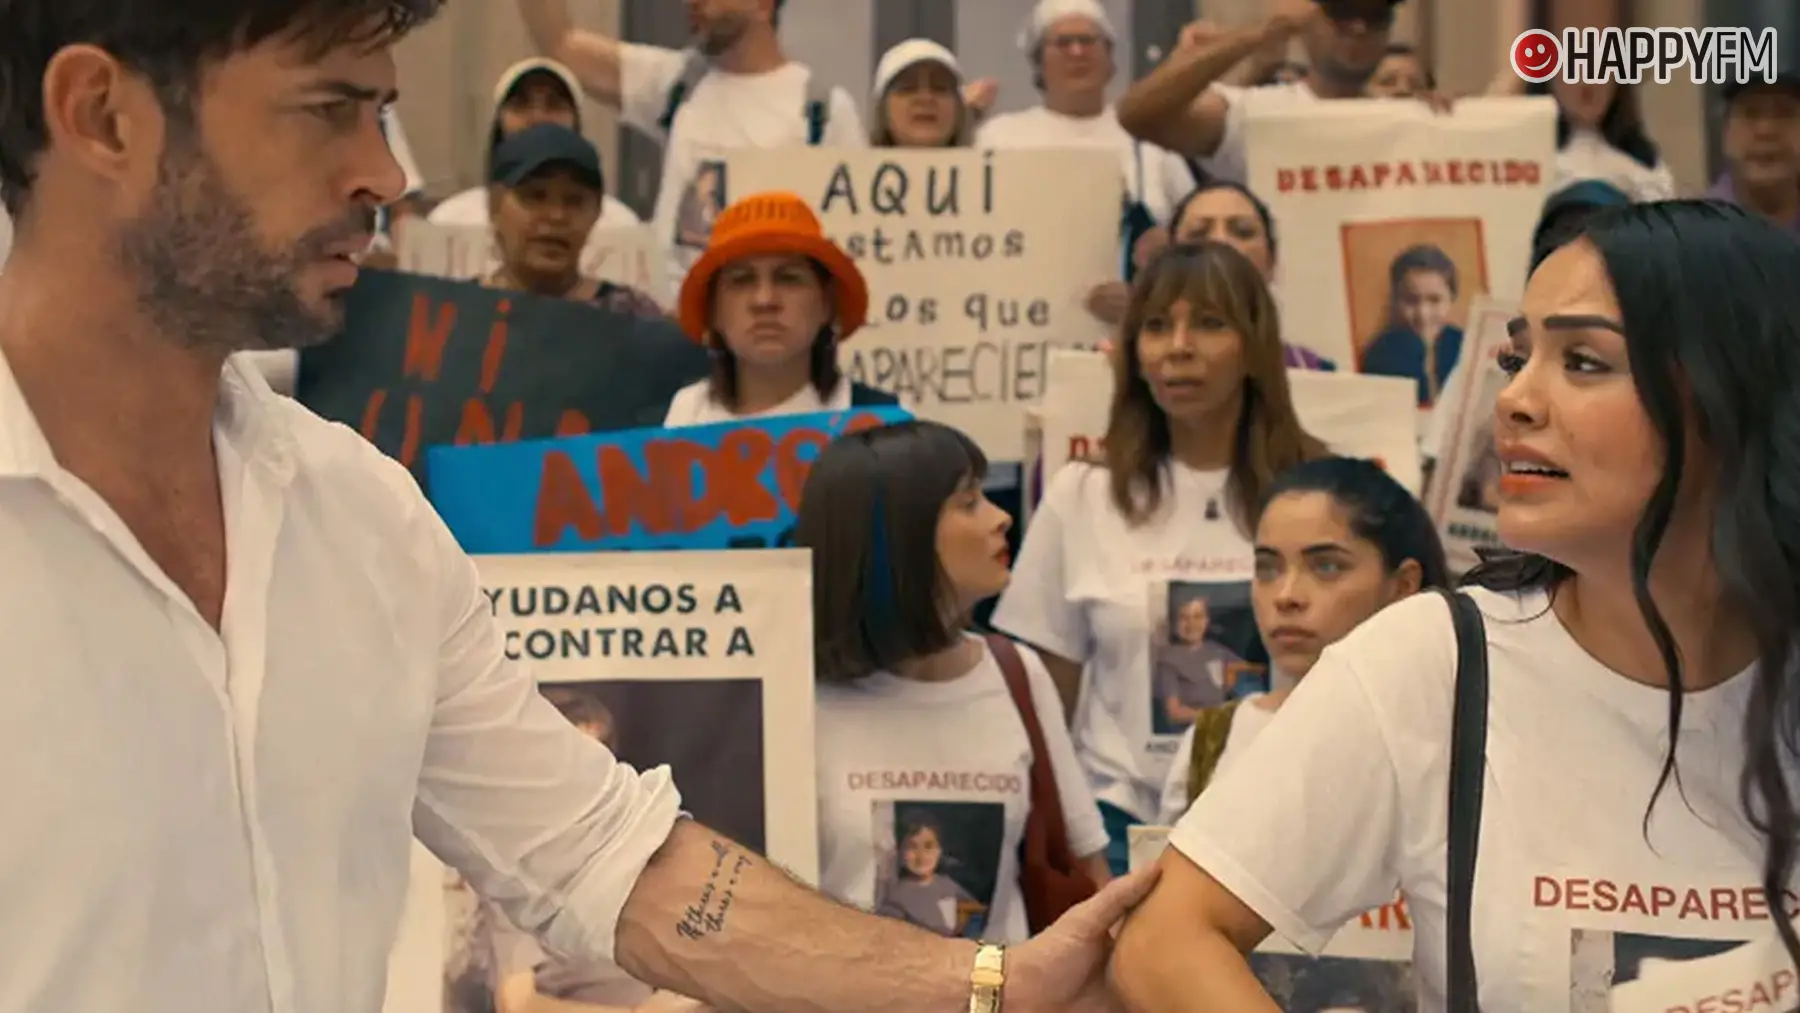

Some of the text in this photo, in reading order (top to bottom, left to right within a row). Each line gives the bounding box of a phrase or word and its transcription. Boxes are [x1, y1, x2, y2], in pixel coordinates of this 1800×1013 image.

[964, 293, 1050, 332] que
[714, 583, 743, 614] A
[725, 626, 755, 657] A
[847, 771, 1022, 794] DESAPARECIDO
